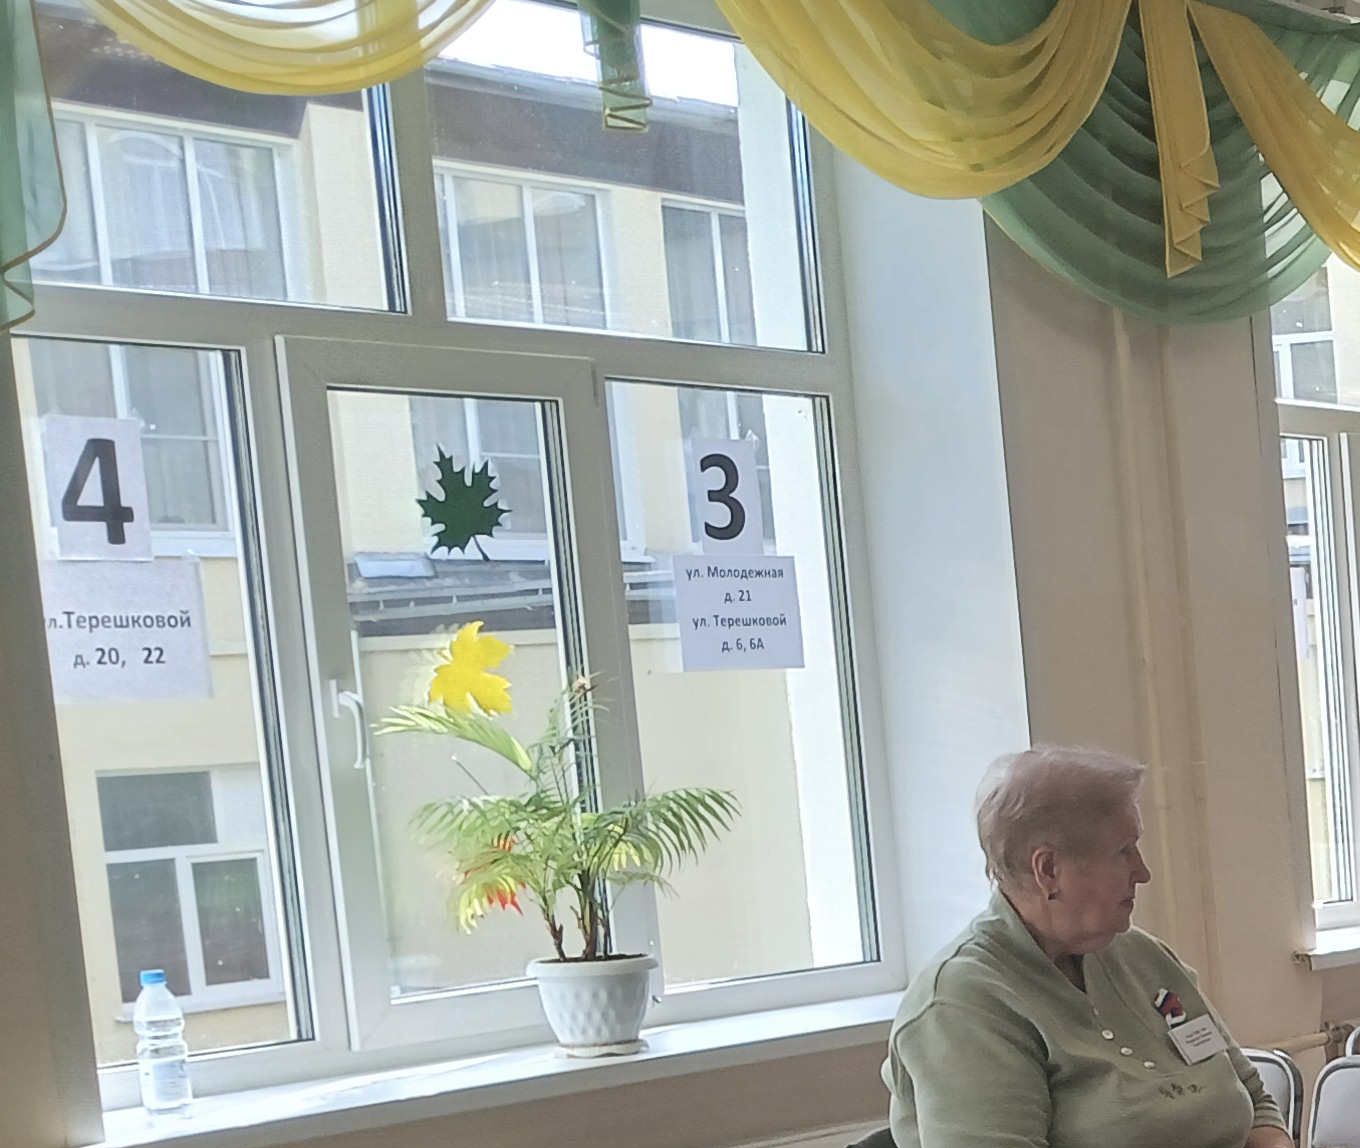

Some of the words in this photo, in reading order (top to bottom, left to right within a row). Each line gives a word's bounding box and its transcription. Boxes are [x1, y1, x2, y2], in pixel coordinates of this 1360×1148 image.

[61, 437, 135, 545] 4
[699, 453, 746, 541] 3
[685, 568, 704, 581] ул.
[707, 566, 784, 580] Молодежная
[724, 592, 735, 604] д.
[738, 589, 752, 602] 21
[45, 610, 192, 633] л.Терешковой
[692, 617, 711, 630] ул.
[713, 613, 787, 629] Терешковой
[721, 641, 733, 653] д.
[736, 637, 747, 653] 6,
[749, 637, 765, 650] 6А
[73, 653, 91, 669] д.
[95, 647, 126, 669] 20,
[142, 646, 166, 665] 22
